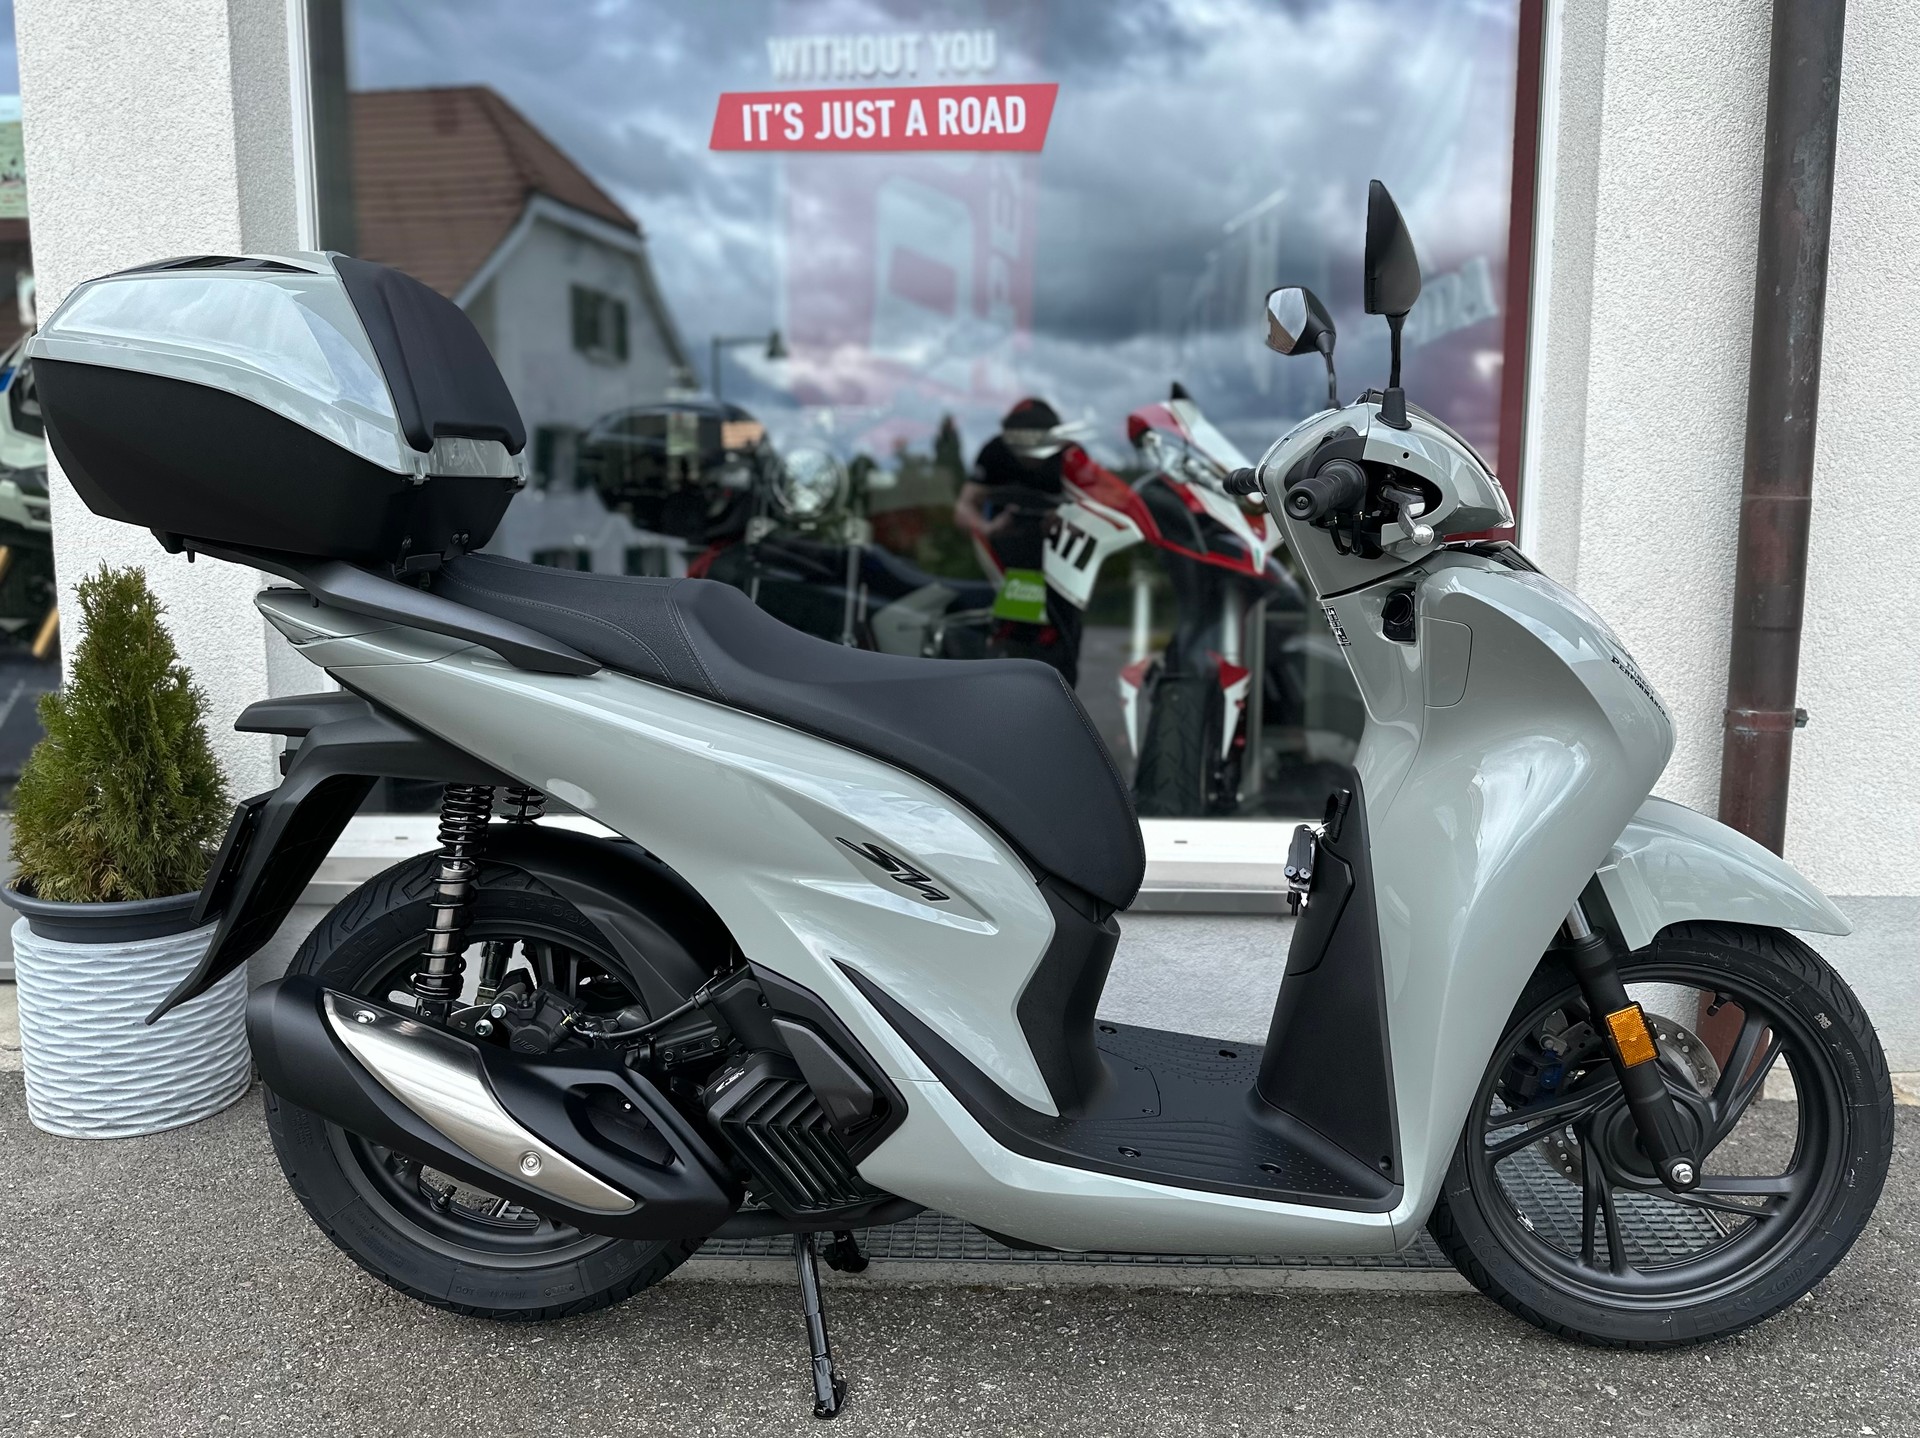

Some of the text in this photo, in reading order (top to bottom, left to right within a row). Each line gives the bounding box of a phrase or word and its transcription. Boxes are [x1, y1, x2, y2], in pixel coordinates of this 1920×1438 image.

[767, 30, 996, 78] WITHOUT YOU
[742, 96, 1026, 141] IT'S JUST A ROAD
